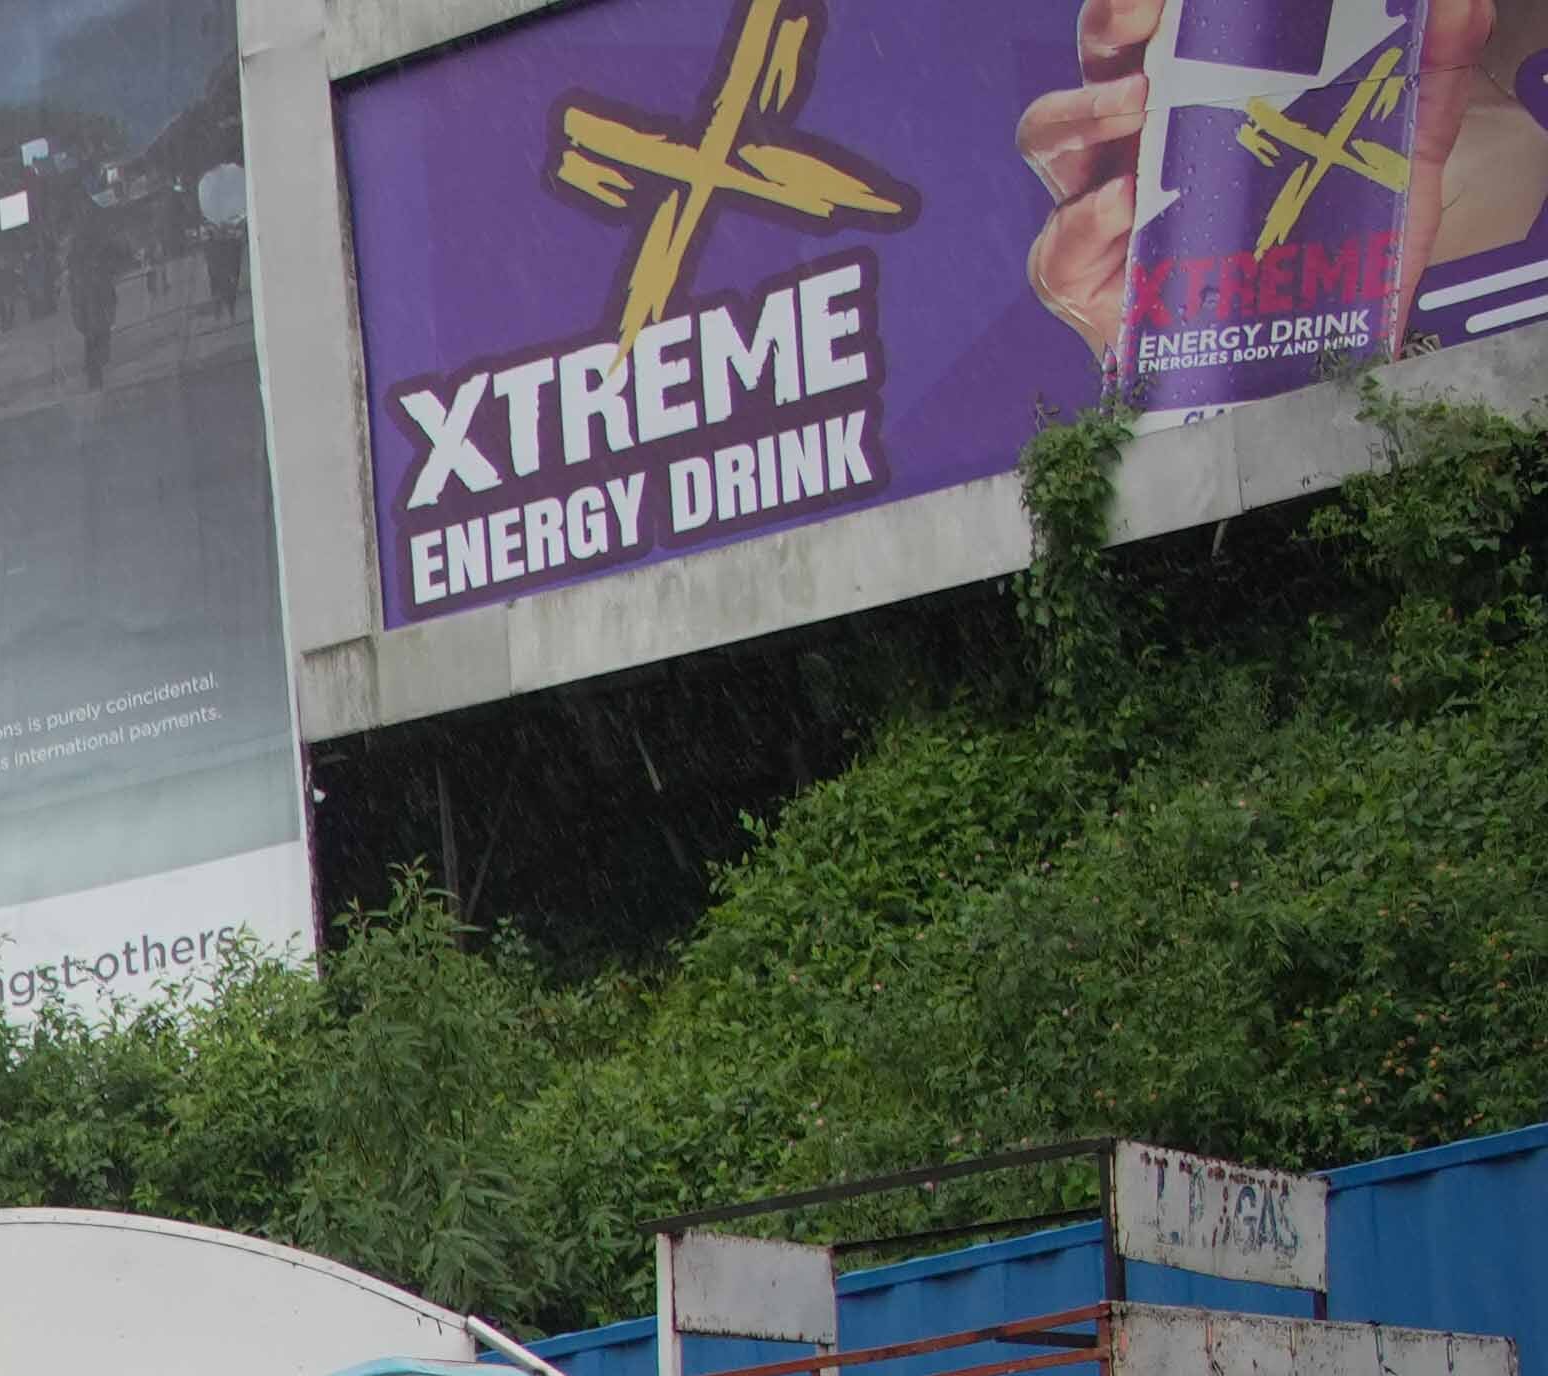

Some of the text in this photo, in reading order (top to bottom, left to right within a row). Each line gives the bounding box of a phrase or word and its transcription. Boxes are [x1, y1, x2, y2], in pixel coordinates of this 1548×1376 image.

[1129, 229, 1402, 328] XTREME
[1138, 350, 1229, 375] ENERGIZES
[1232, 345, 1279, 364] BODY
[1282, 339, 1319, 357] AND
[1139, 310, 1371, 358] ENERGY DRINK
[399, 263, 867, 511] XTREME
[409, 413, 872, 605] ENERGY DRINK
[27, 714, 43, 734] is
[47, 701, 101, 731] purely
[106, 672, 220, 715] coincidental.
[14, 726, 125, 770] International
[129, 704, 222, 744] payments.
